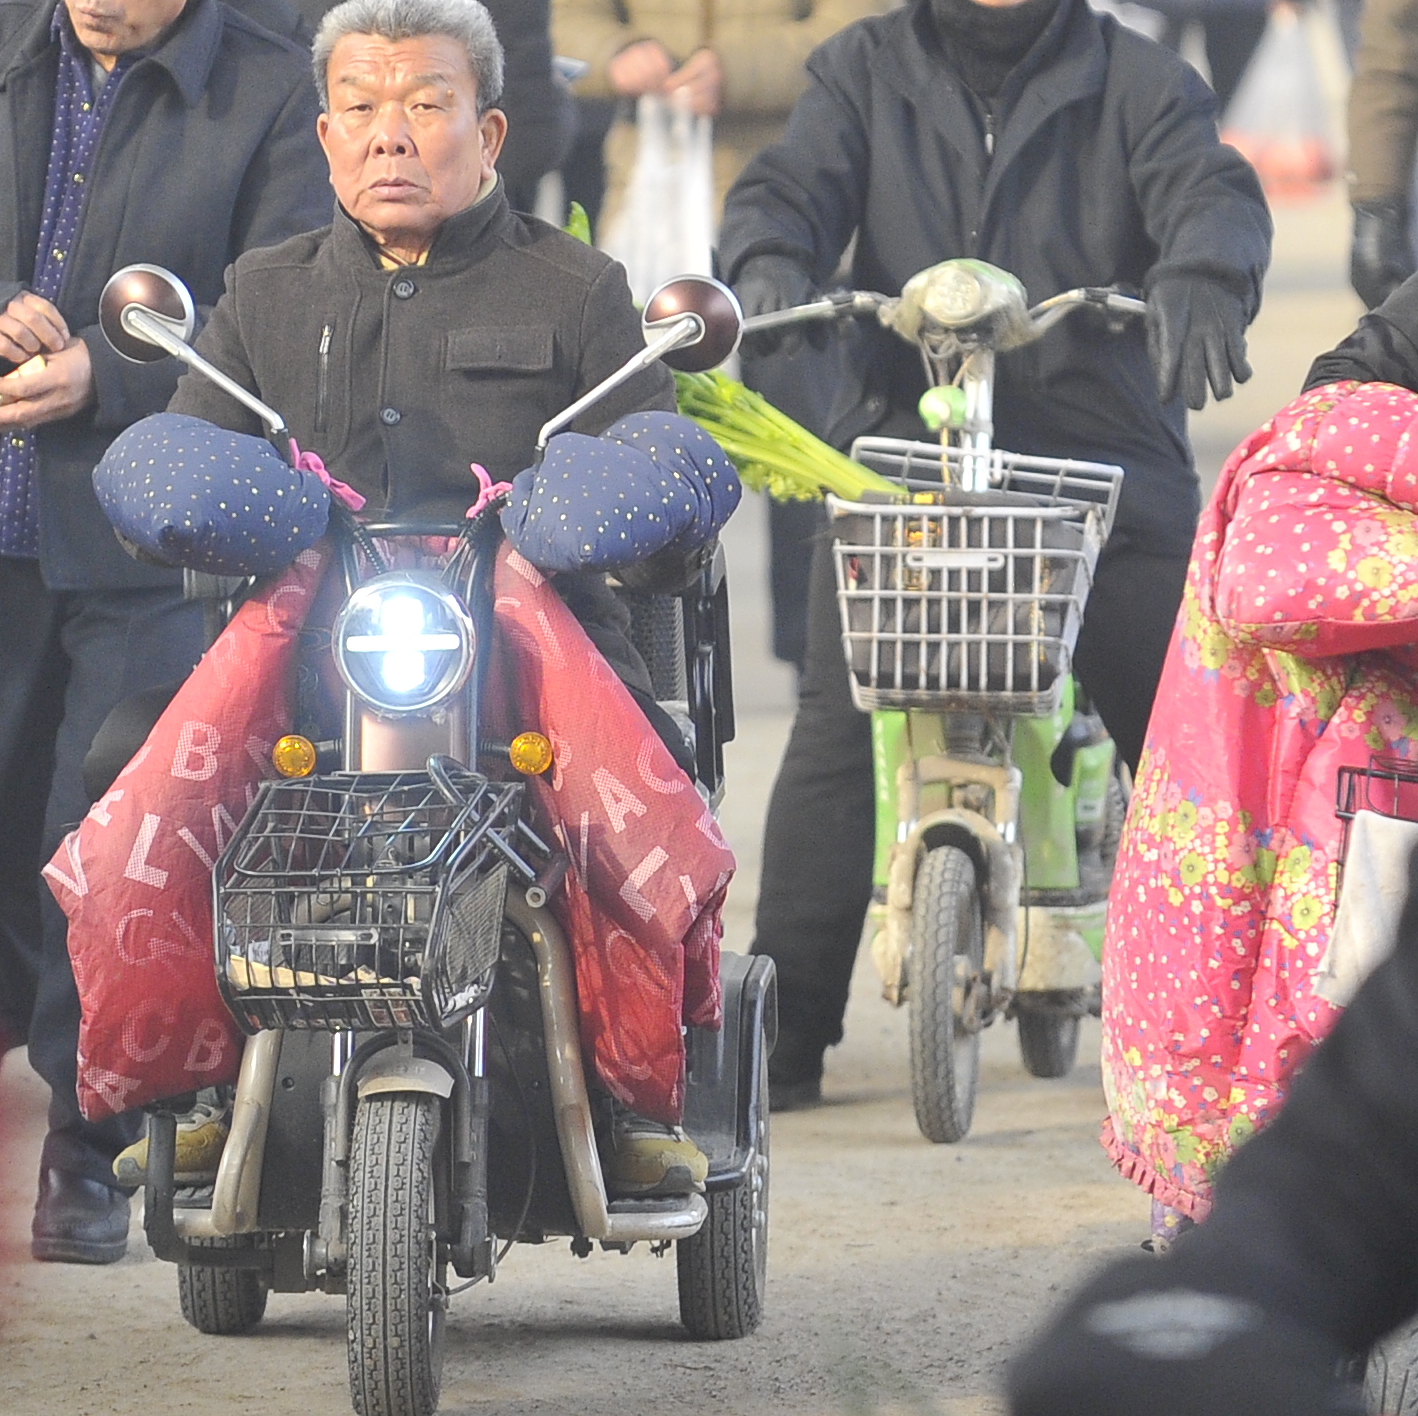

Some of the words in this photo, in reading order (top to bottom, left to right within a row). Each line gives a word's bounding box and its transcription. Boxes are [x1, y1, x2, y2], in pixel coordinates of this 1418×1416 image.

[171, 720, 222, 781] B
[591, 765, 648, 833] A
[123, 812, 169, 890] L
[618, 845, 670, 923] L
[183, 1018, 228, 1072] B
